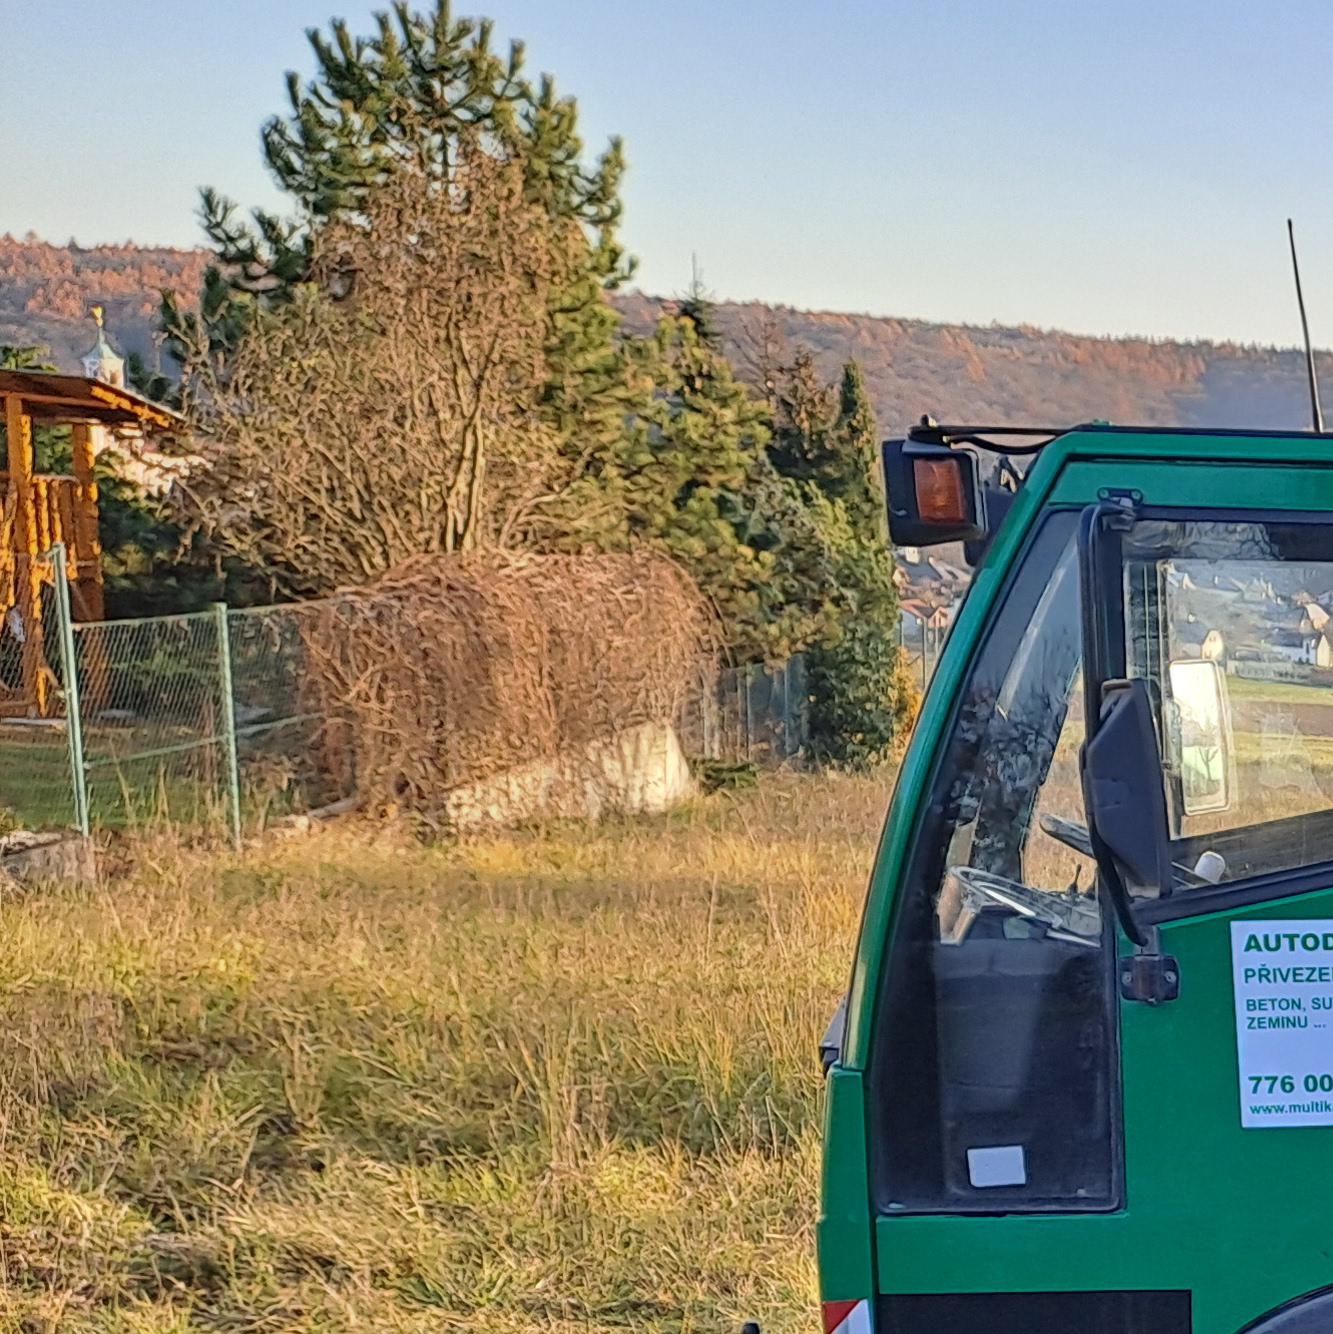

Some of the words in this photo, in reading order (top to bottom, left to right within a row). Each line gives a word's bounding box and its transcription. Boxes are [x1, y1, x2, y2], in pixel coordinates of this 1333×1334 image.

[1246, 997, 1307, 1013] BETON,
[1247, 1016, 1308, 1029] ZEMINU
[1248, 1075, 1295, 1095] 776
